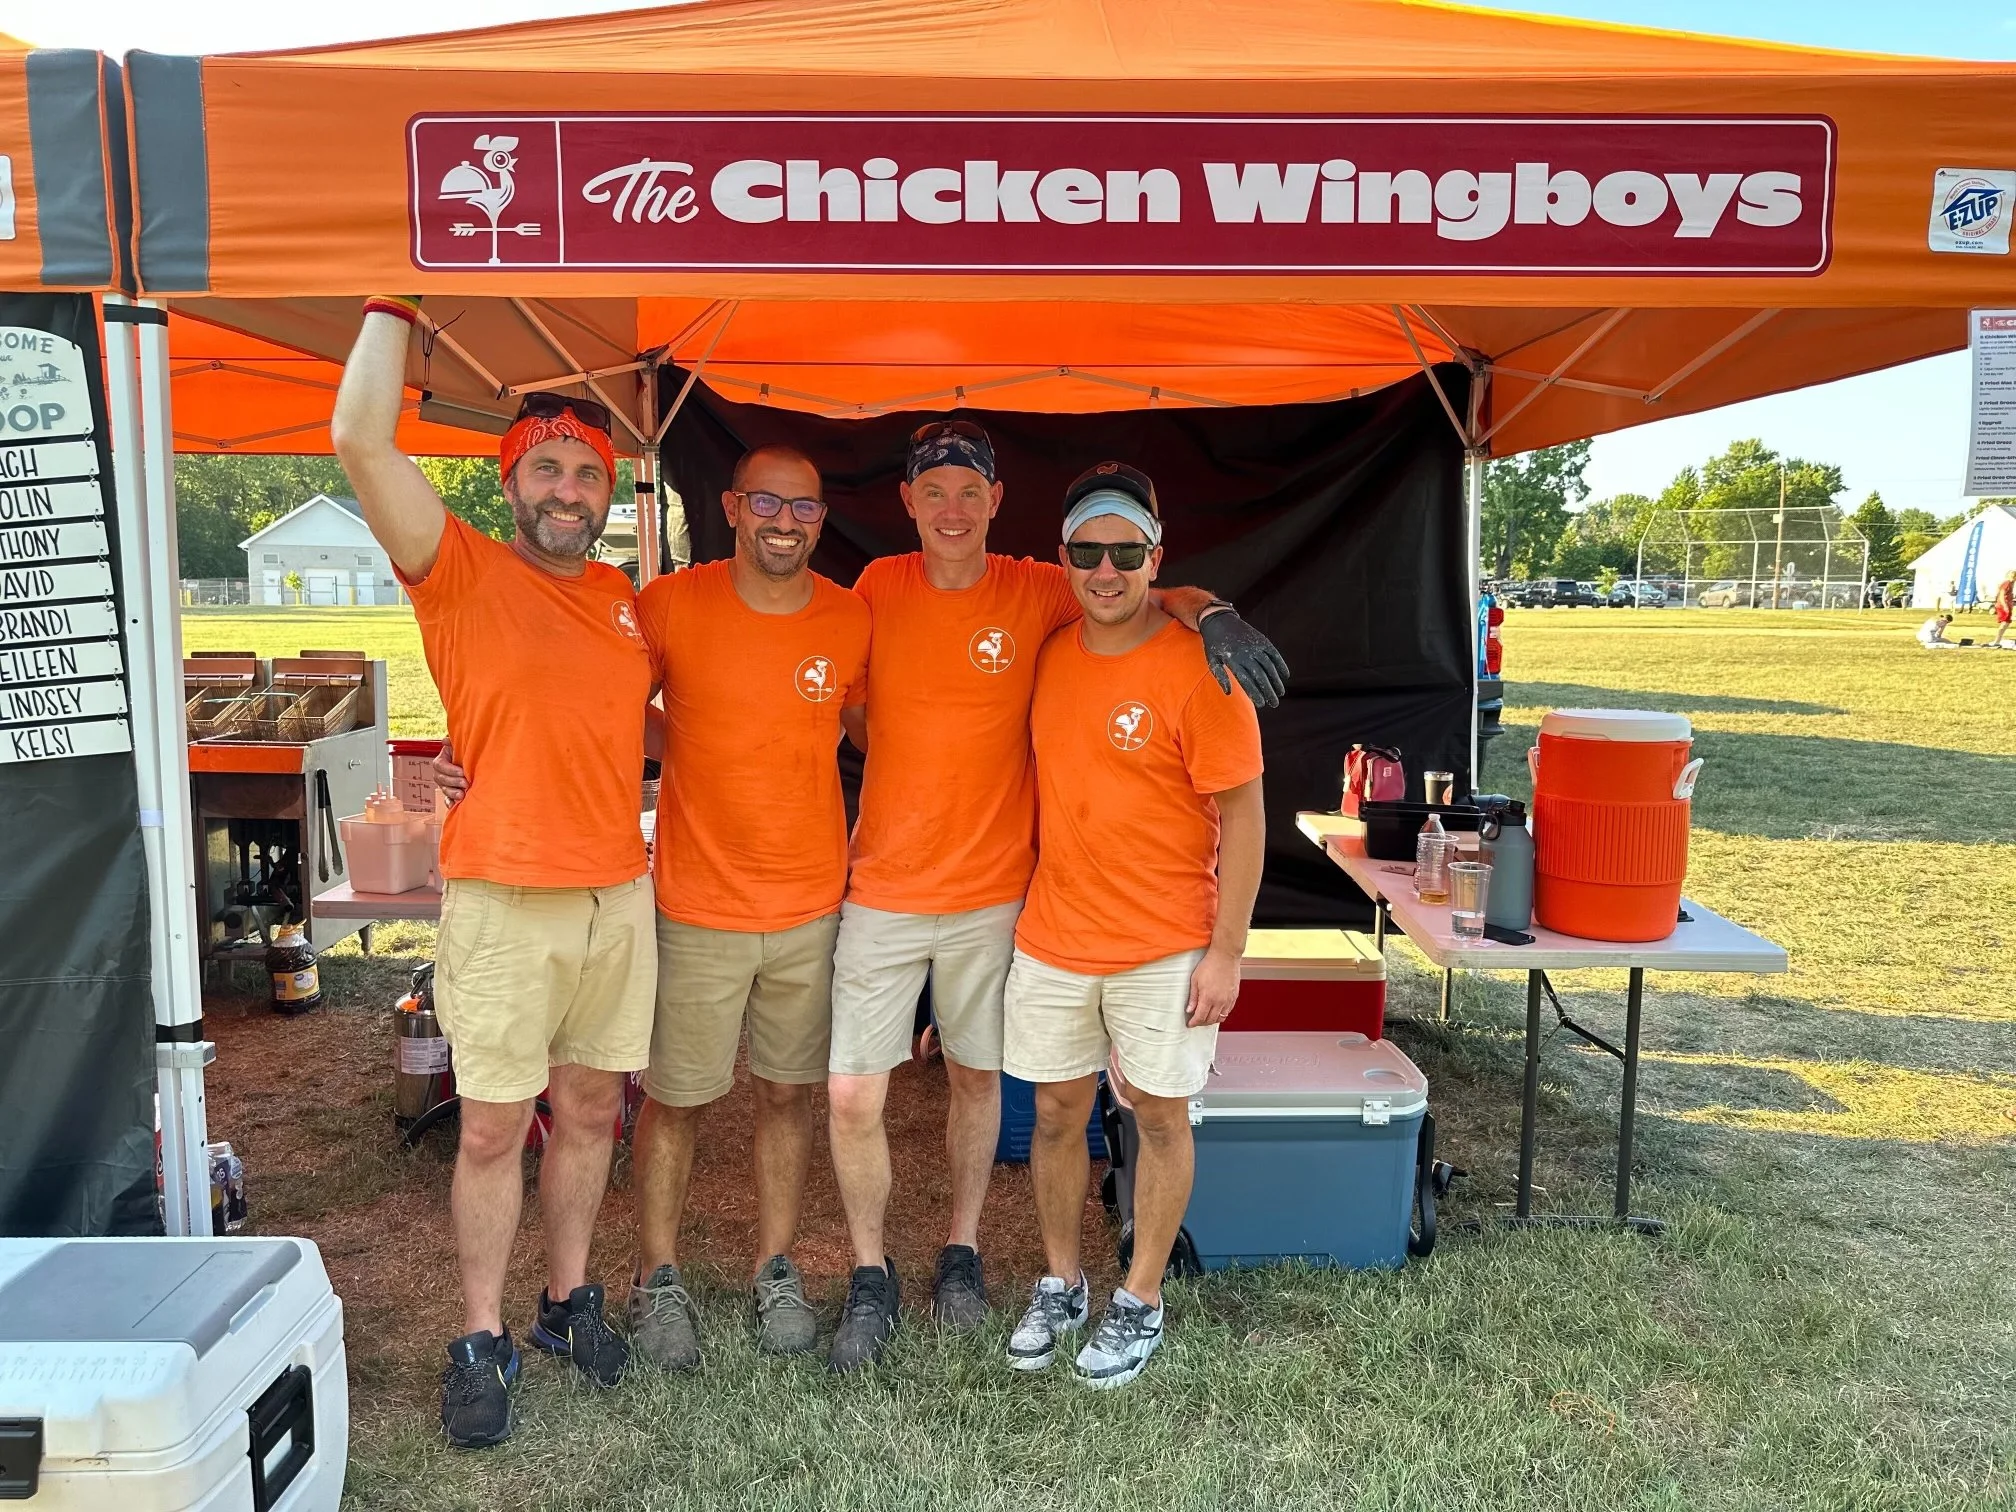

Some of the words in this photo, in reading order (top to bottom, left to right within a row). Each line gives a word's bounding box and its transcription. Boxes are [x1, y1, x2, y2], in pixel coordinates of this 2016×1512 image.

[582, 156, 700, 225] The
[711, 157, 1181, 226] Chicken
[1203, 158, 1803, 242] Wingboys
[0, 332, 54, 354] OME
[0, 402, 66, 433] OP
[0, 646, 79, 683] EILEEN
[0, 686, 82, 721] LINDSEY
[11, 726, 75, 760] KELSI
